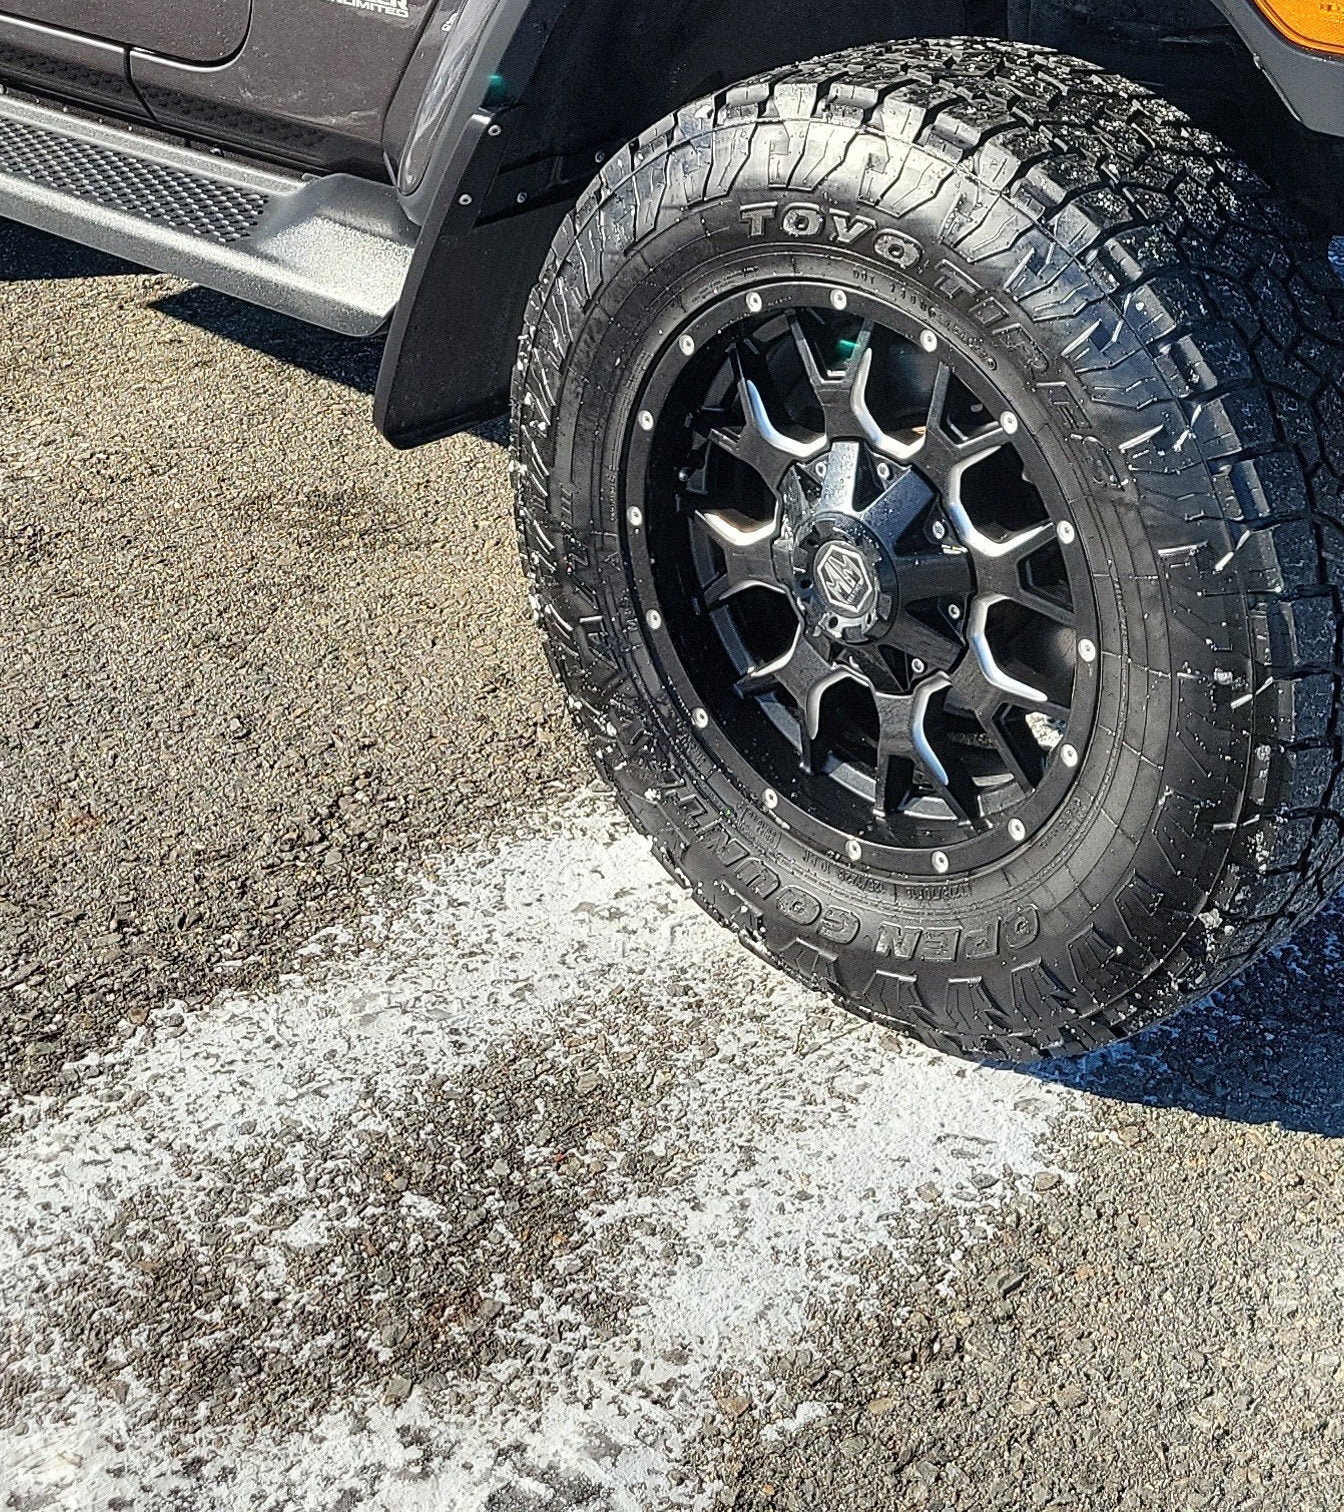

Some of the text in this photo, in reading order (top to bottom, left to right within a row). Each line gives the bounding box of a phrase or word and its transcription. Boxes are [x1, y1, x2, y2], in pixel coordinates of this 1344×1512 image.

[739, 200, 924, 269] TOYO
[934, 257, 1127, 489] TIRES
[875, 901, 1040, 961] OPEN
